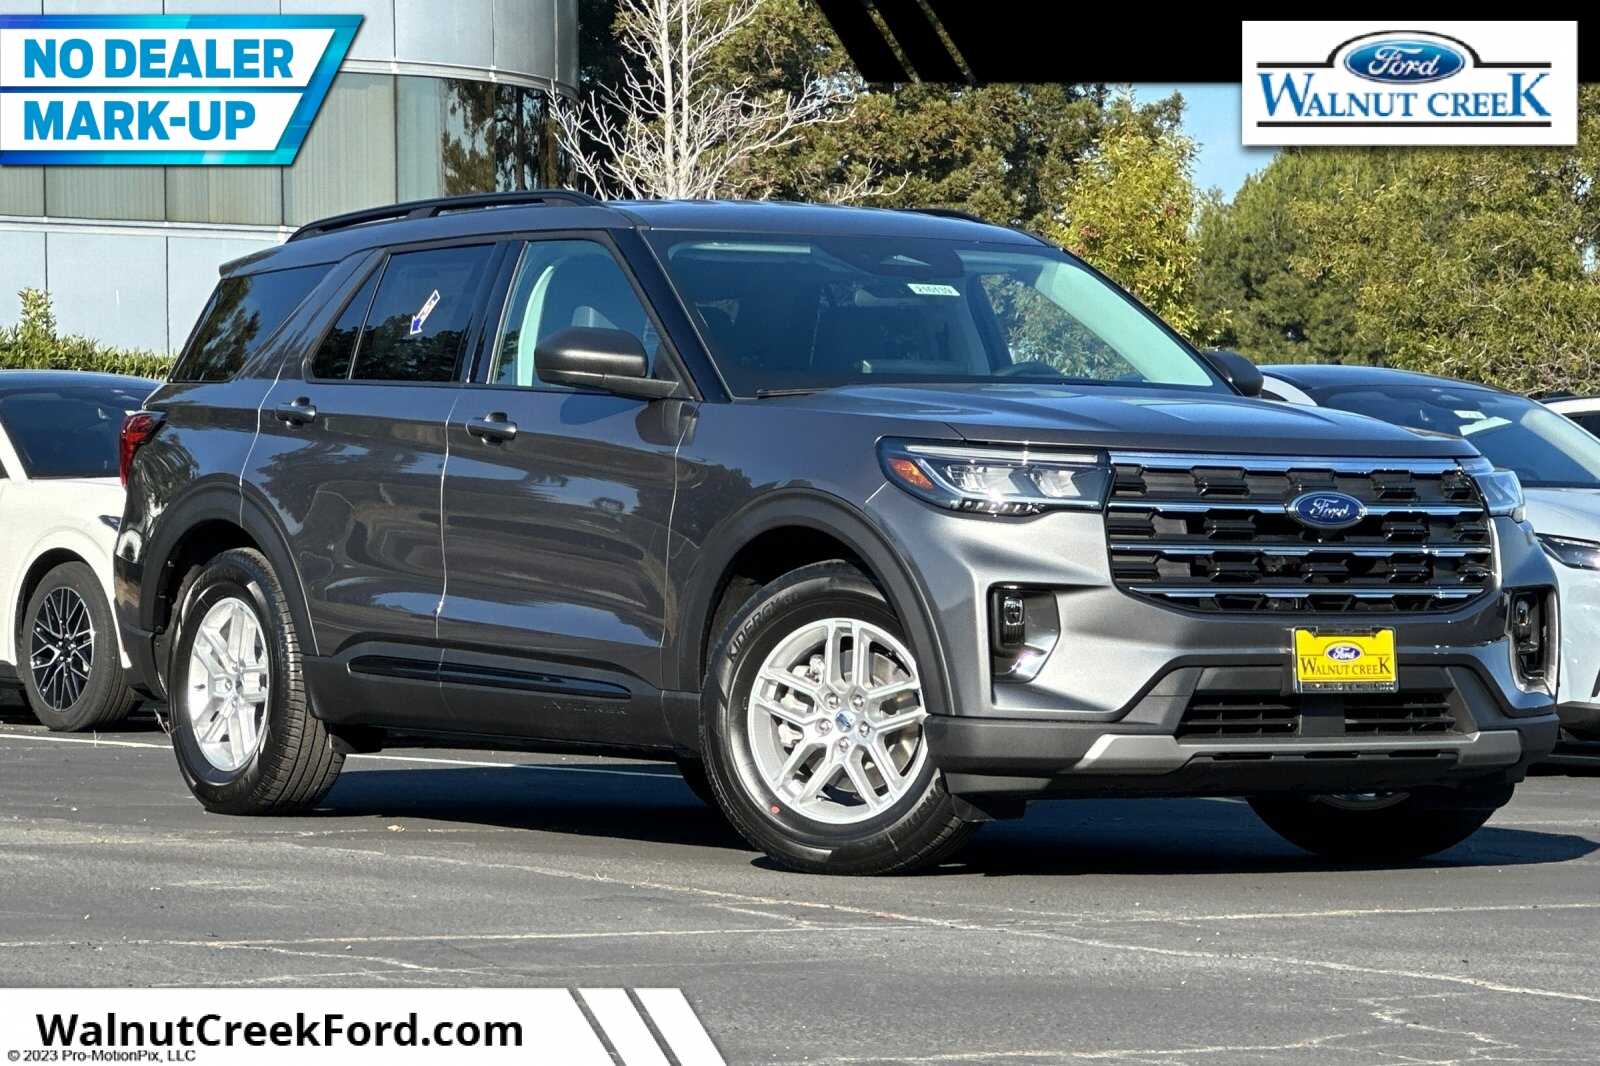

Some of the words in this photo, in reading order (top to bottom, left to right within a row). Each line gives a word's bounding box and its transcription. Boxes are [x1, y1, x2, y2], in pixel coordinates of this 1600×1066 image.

[1309, 498, 1350, 518] Ford
[1300, 657, 1349, 675] WALNUT
[1352, 656, 1391, 675] CREEK
